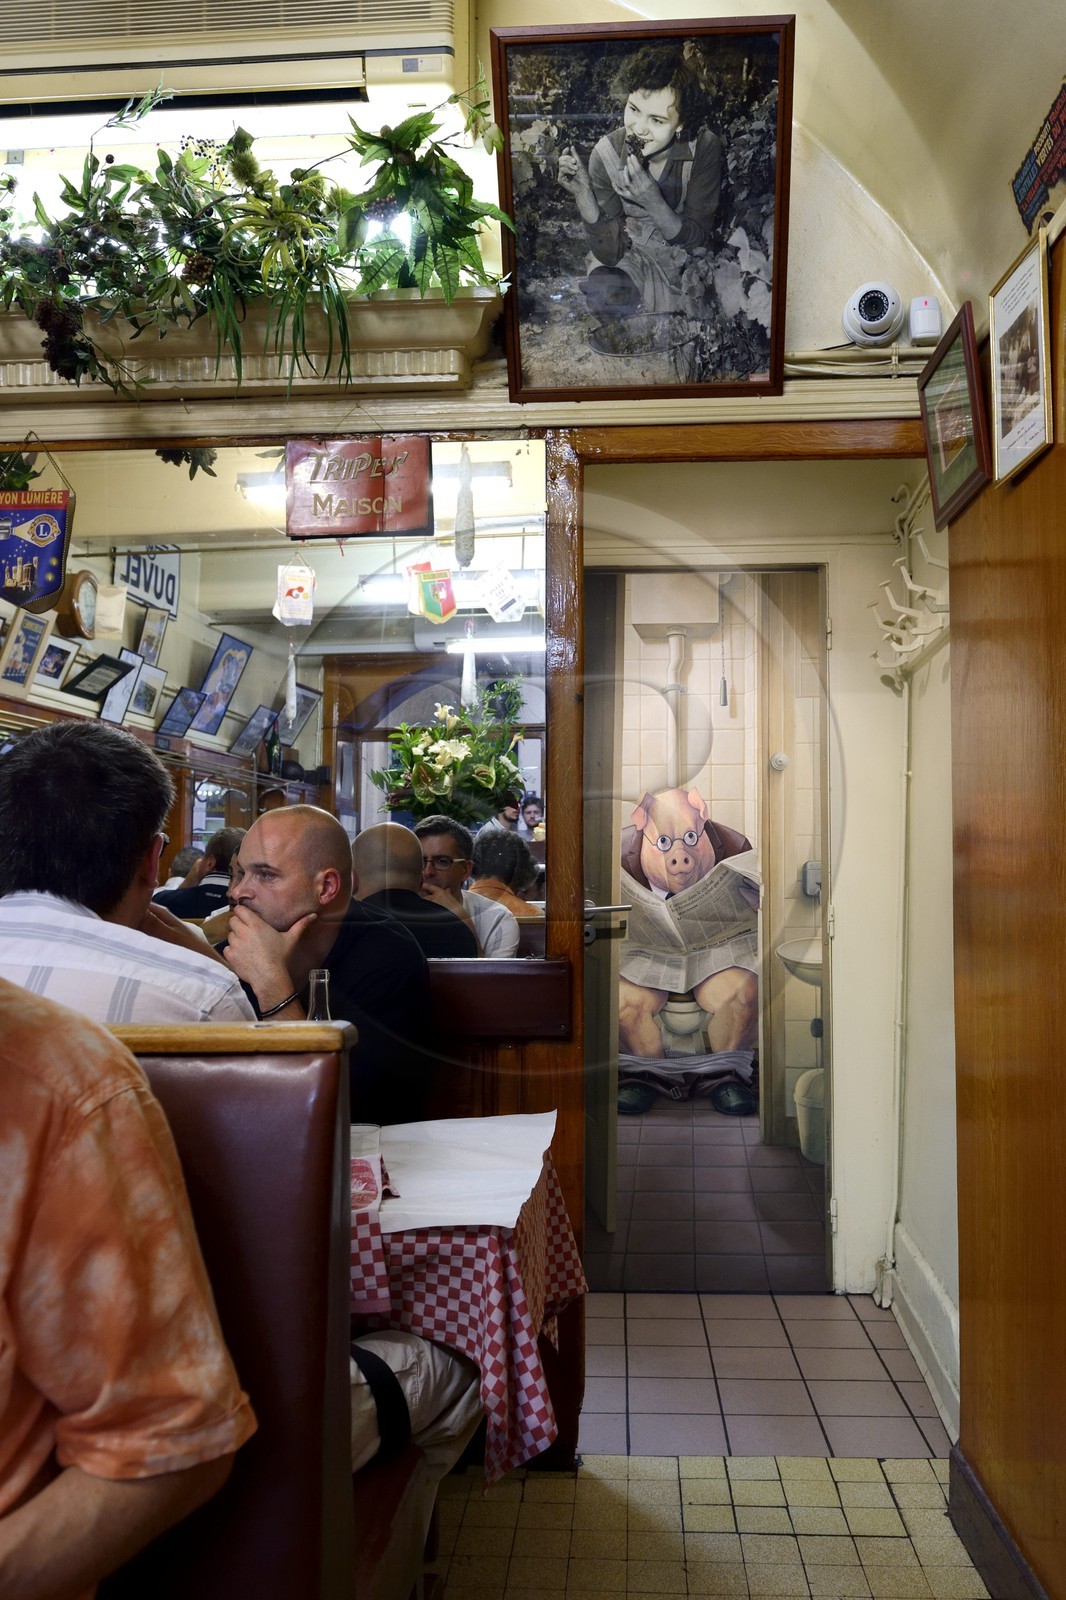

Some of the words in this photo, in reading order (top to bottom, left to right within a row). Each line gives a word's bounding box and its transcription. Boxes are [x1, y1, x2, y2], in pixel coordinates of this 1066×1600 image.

[1036, 134, 1054, 168] VERTES
[308, 451, 409, 482] TRIPES
[312, 493, 403, 517] MAISON
[38, 524, 48, 537] L
